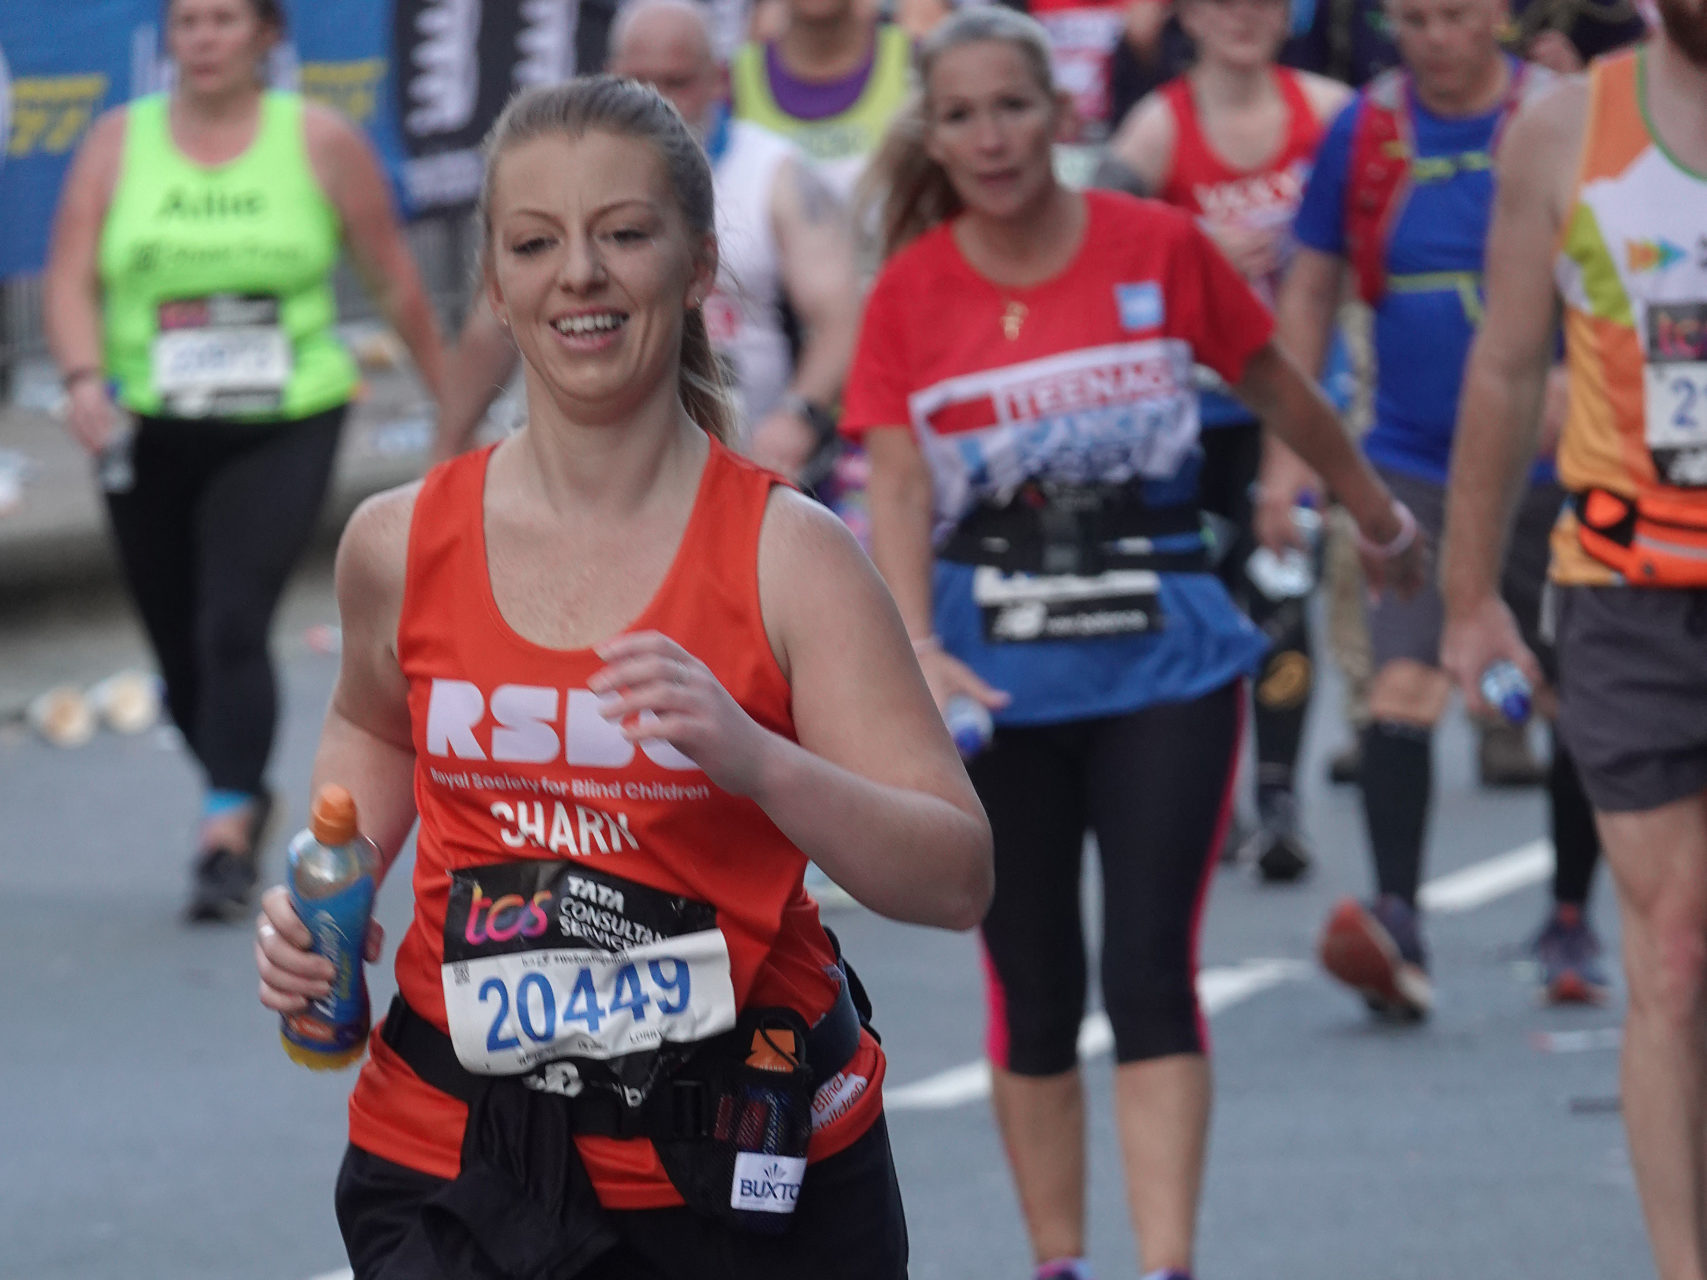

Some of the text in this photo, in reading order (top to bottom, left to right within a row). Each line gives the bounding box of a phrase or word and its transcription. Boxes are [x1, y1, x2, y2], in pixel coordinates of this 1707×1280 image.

[430, 767, 711, 801] Royal Society for Blind Children
[464, 881, 553, 946] tcs
[567, 875, 625, 914] TATA
[478, 956, 692, 1054] 20449
[811, 1071, 844, 1115] Blind
